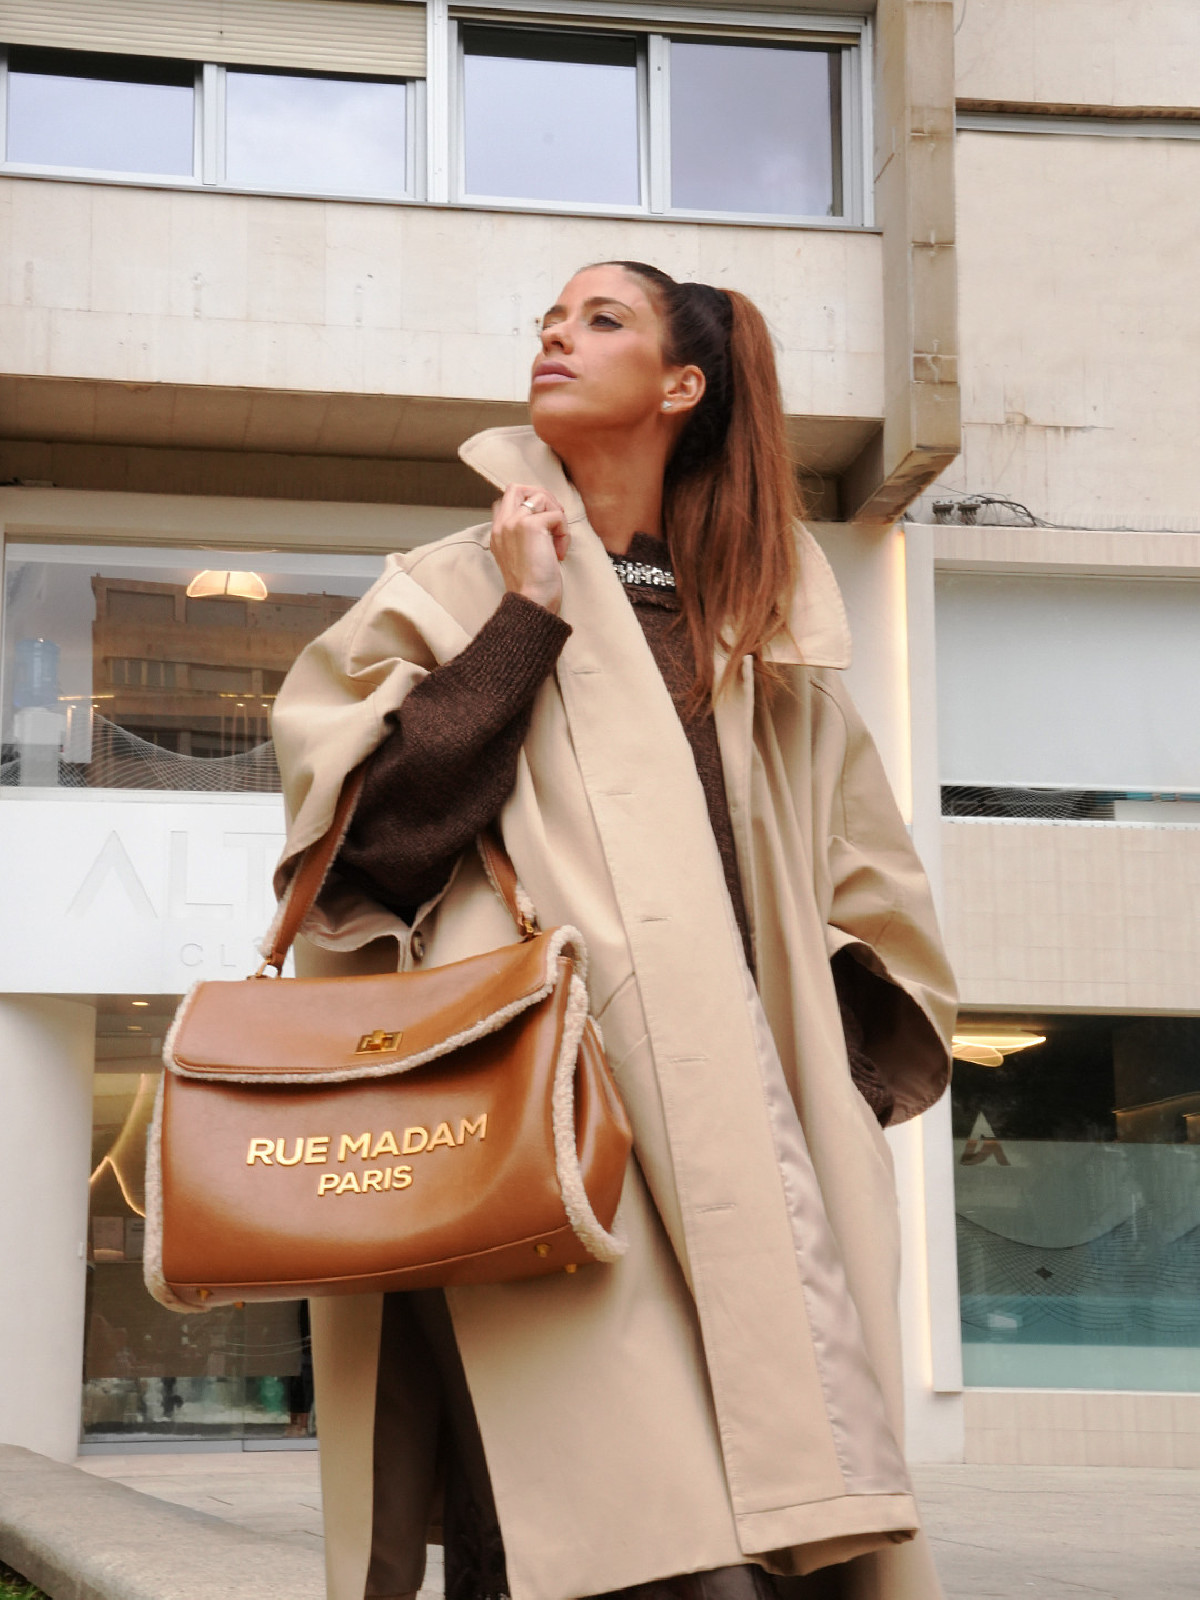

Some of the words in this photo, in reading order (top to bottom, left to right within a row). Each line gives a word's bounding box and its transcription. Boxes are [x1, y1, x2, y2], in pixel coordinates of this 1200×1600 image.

[246, 1136, 330, 1166] RUE
[337, 1113, 488, 1162] MADAM
[317, 1165, 413, 1196] PARIS
